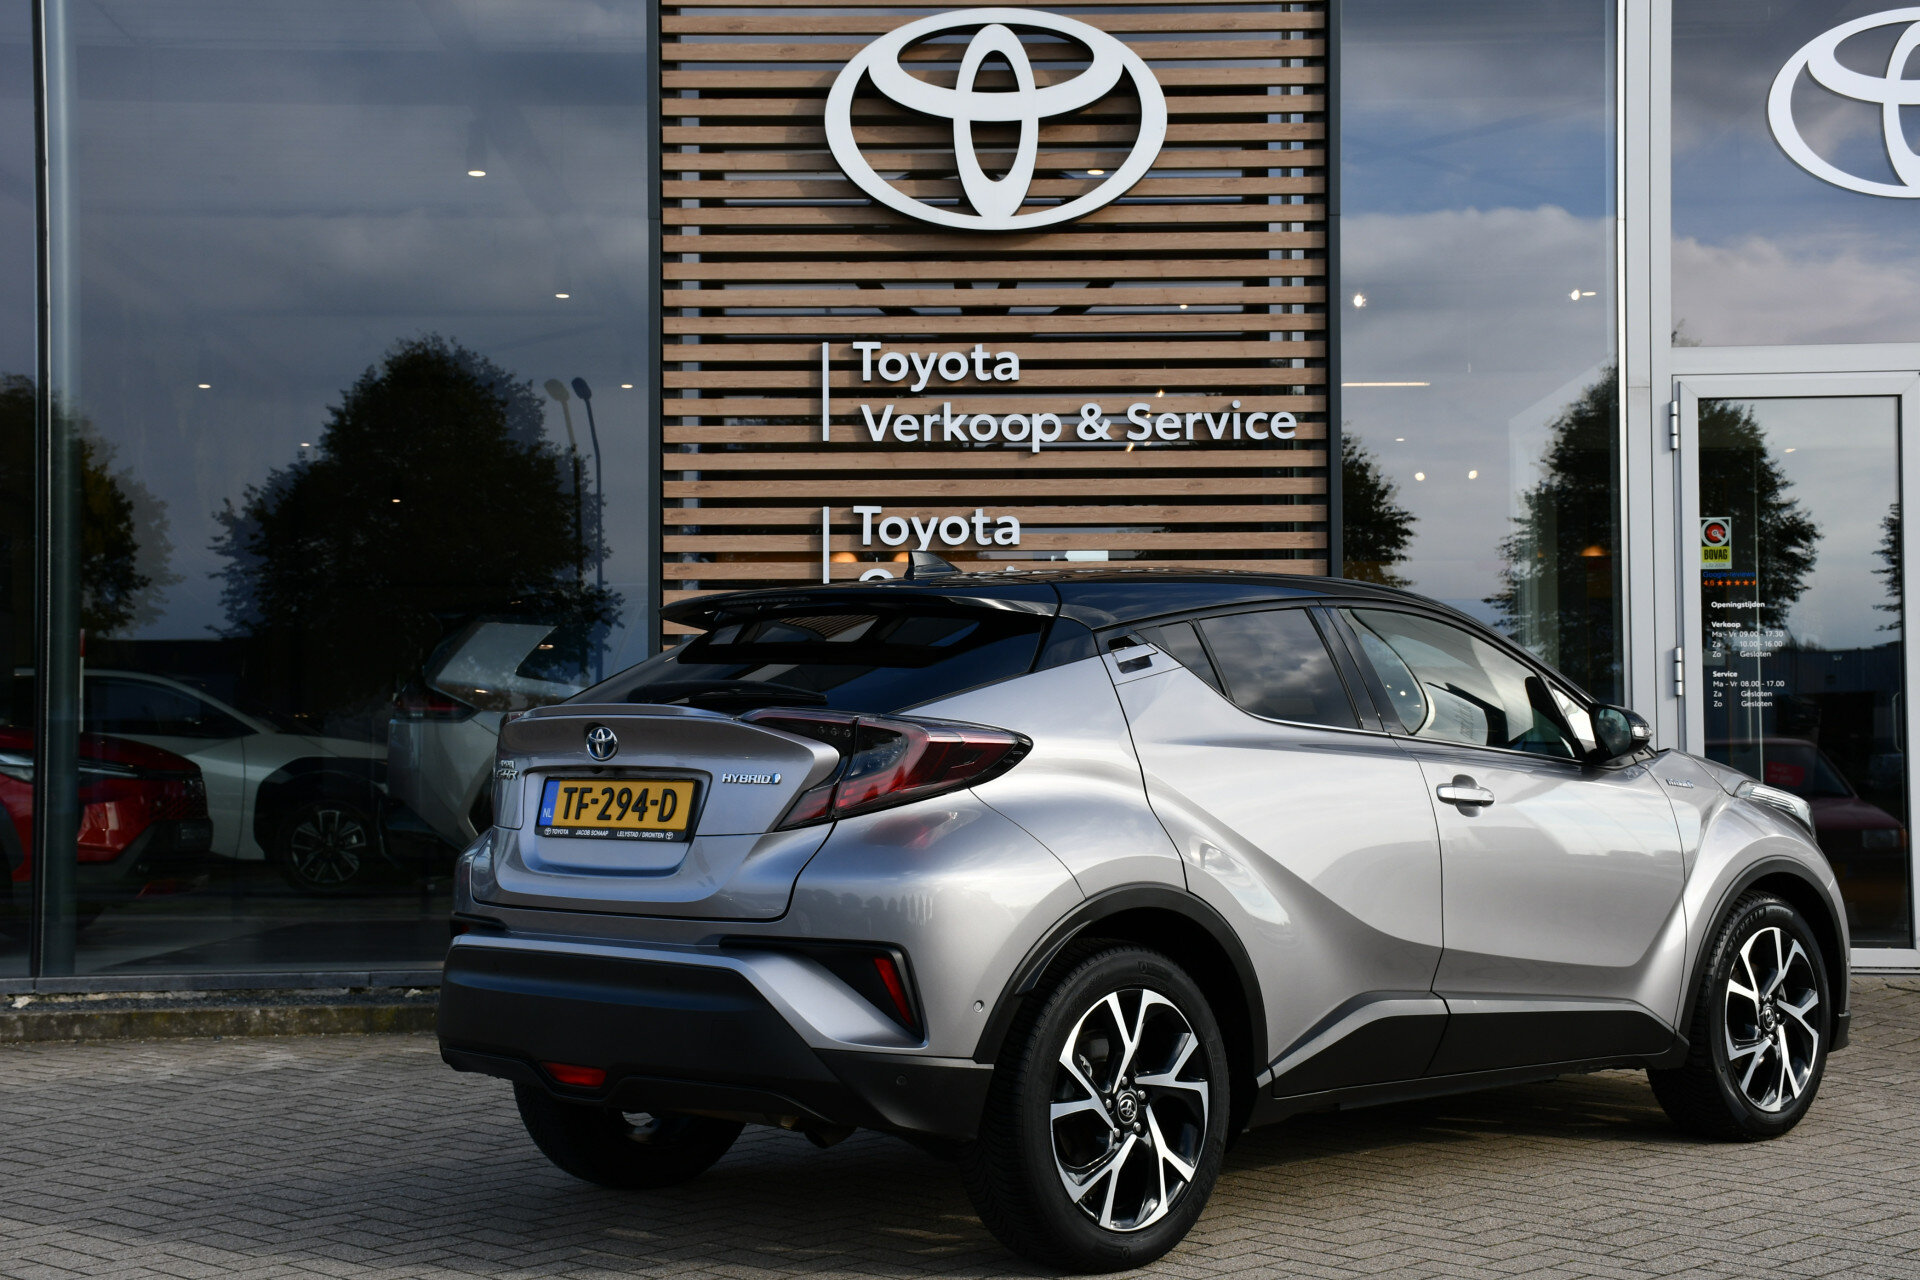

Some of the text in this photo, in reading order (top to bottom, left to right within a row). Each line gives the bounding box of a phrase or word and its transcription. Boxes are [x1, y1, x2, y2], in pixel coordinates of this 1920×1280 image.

[854, 342, 1021, 393] Toyota
[861, 401, 1298, 454] Verkoop & Service
[854, 505, 1021, 553] Toyota
[1704, 549, 1728, 560] BOVAG
[1711, 601, 1765, 609] Openingstijden
[1711, 621, 1741, 629] Verkoop
[722, 773, 771, 784] HYBRID
[563, 787, 678, 823] TF-294-D
[542, 808, 553, 818] NL
